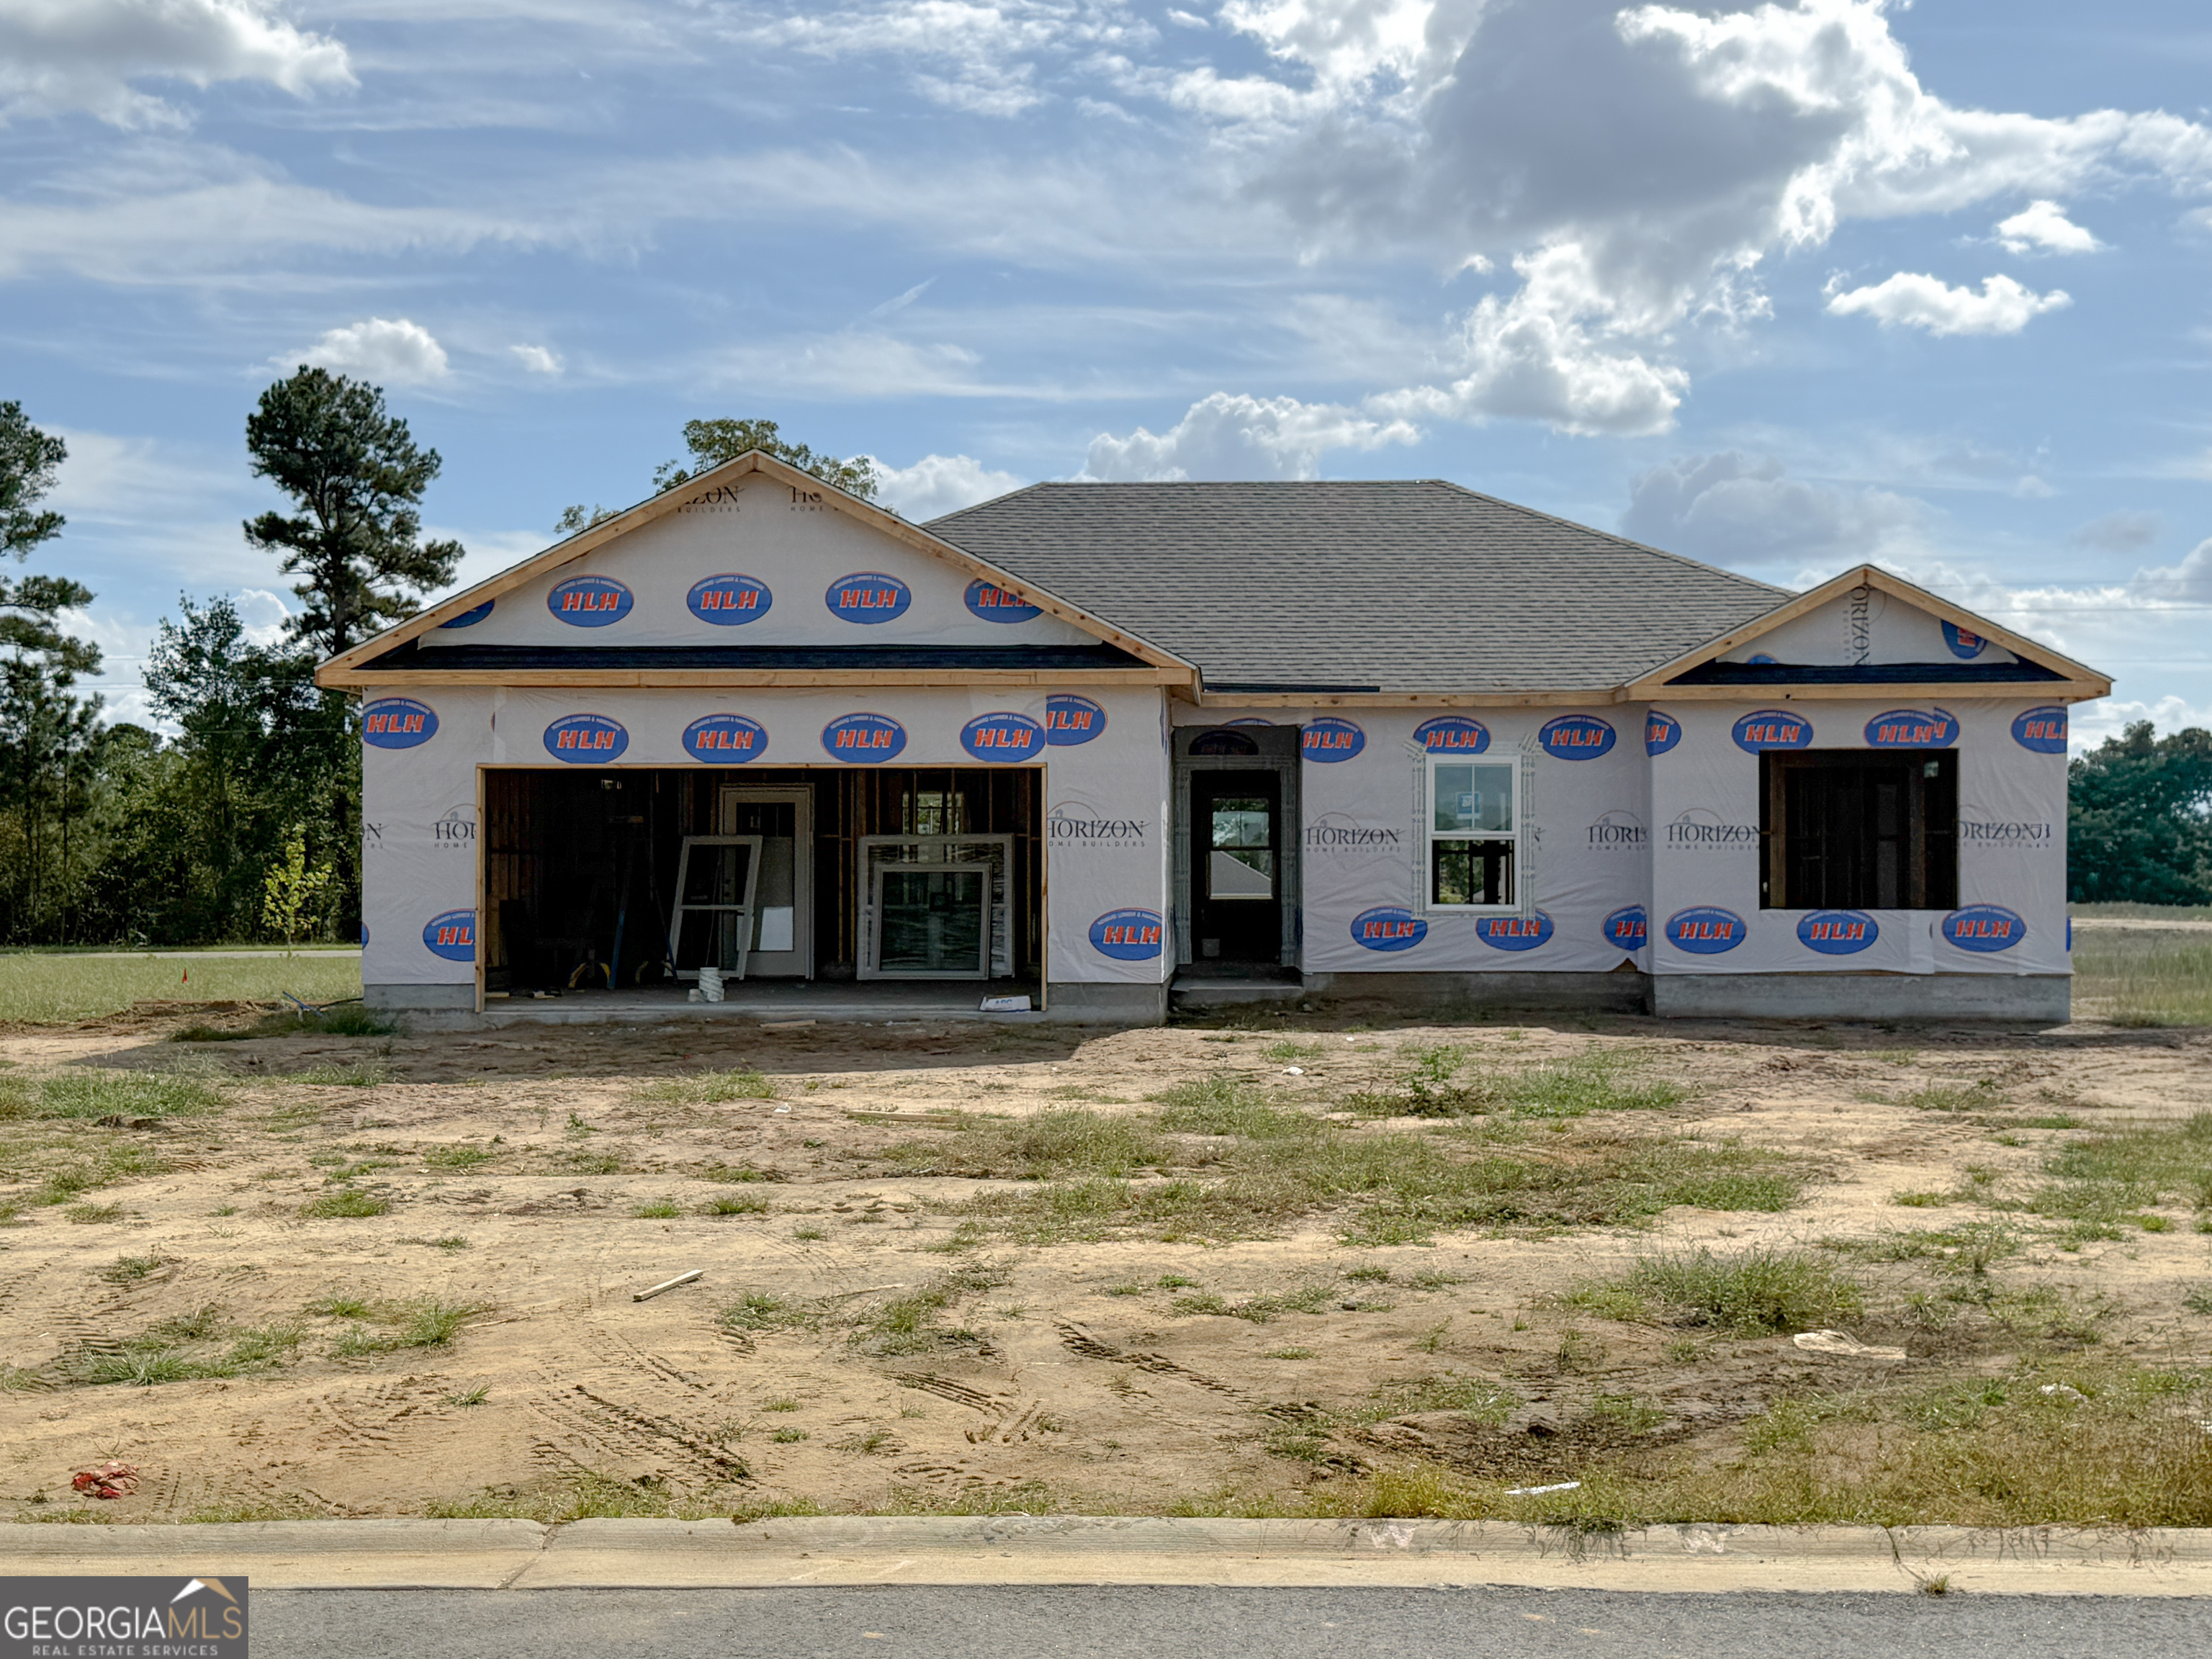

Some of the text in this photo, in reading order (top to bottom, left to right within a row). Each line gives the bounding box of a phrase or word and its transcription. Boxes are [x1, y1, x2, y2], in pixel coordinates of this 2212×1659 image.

[562, 593, 619, 611] HLH
[701, 590, 759, 610] HLH
[839, 589, 898, 608] HLH
[1851, 586, 1871, 666] ORIZON
[367, 714, 425, 733] HLH
[557, 729, 616, 750] HLH
[696, 729, 755, 750] HLH
[835, 729, 894, 748] HLH
[974, 729, 1033, 748] HLH
[1303, 731, 1354, 749] HLH
[1426, 730, 1478, 748] HLH
[1550, 729, 1605, 747] HLH
[1744, 724, 1800, 742] HLH
[1306, 828, 1400, 845] HORIZON
[436, 926, 474, 945] HL
[1102, 926, 1161, 945] HLH
[1363, 921, 1416, 938] HLH
[1488, 920, 1542, 937] HLH
[1678, 922, 1733, 940] HLH
[1809, 922, 1866, 940] HLH
[1954, 920, 2011, 938] HLH
